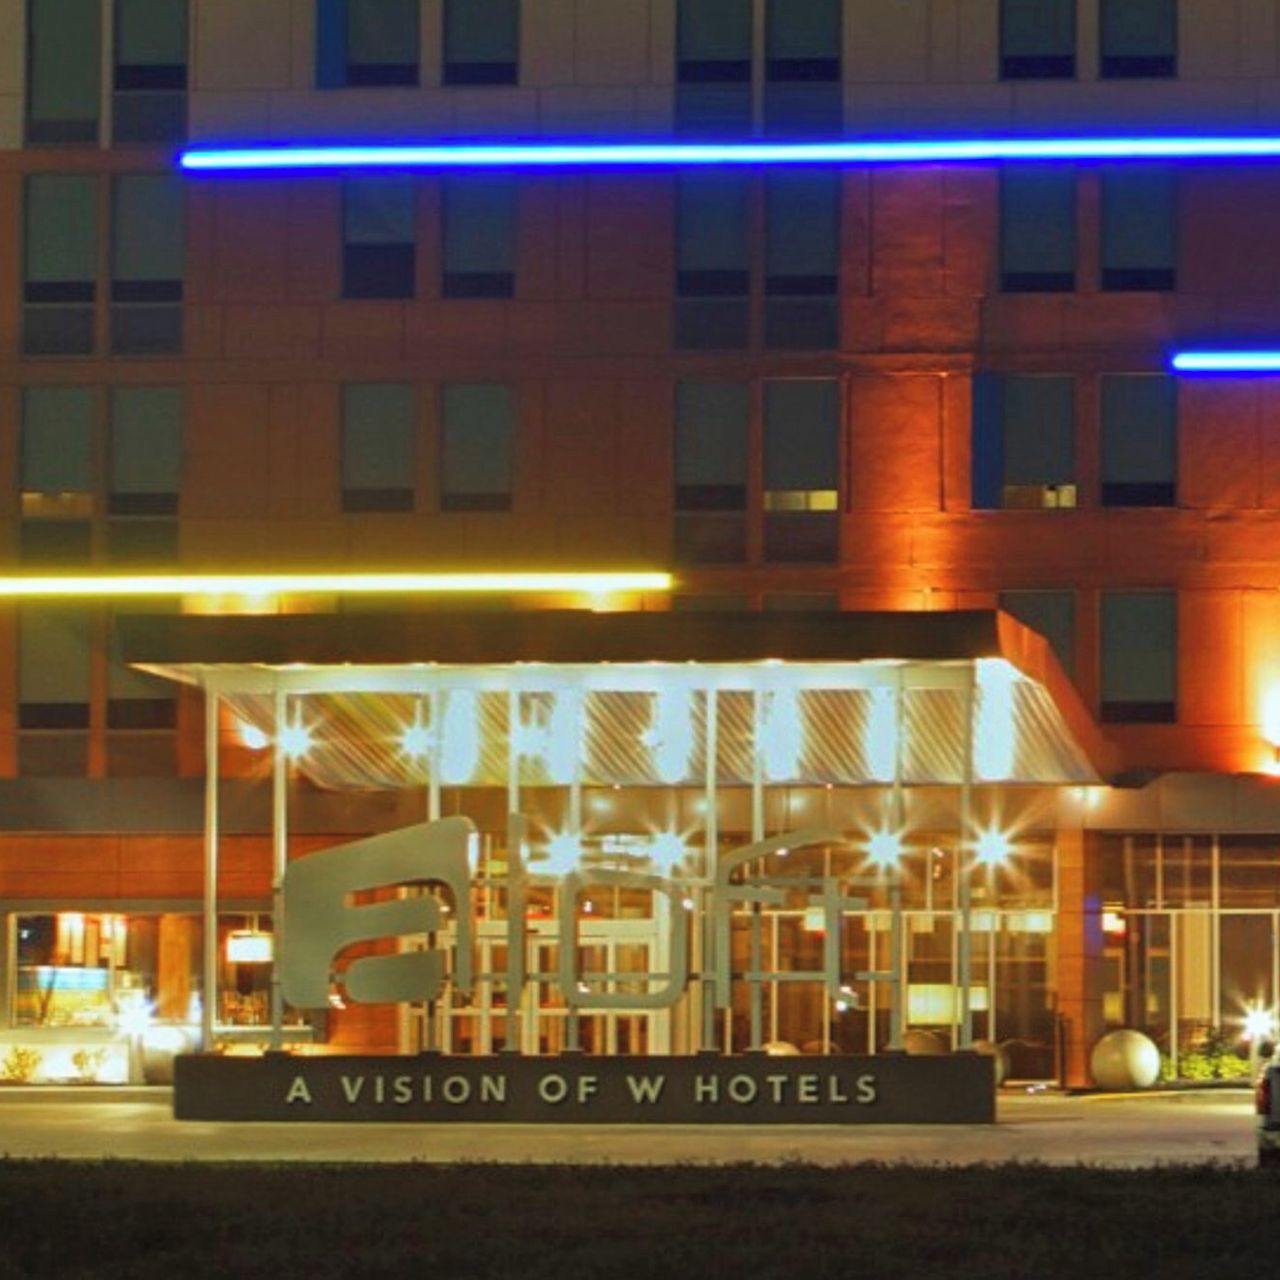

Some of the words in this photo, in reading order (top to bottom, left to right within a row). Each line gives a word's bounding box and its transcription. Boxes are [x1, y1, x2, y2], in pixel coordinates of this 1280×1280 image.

[286, 1077, 312, 1103] A
[340, 1075, 507, 1103] VISION
[538, 1075, 598, 1102] OF
[627, 1075, 665, 1102] W
[695, 1074, 877, 1103] HOTELS
